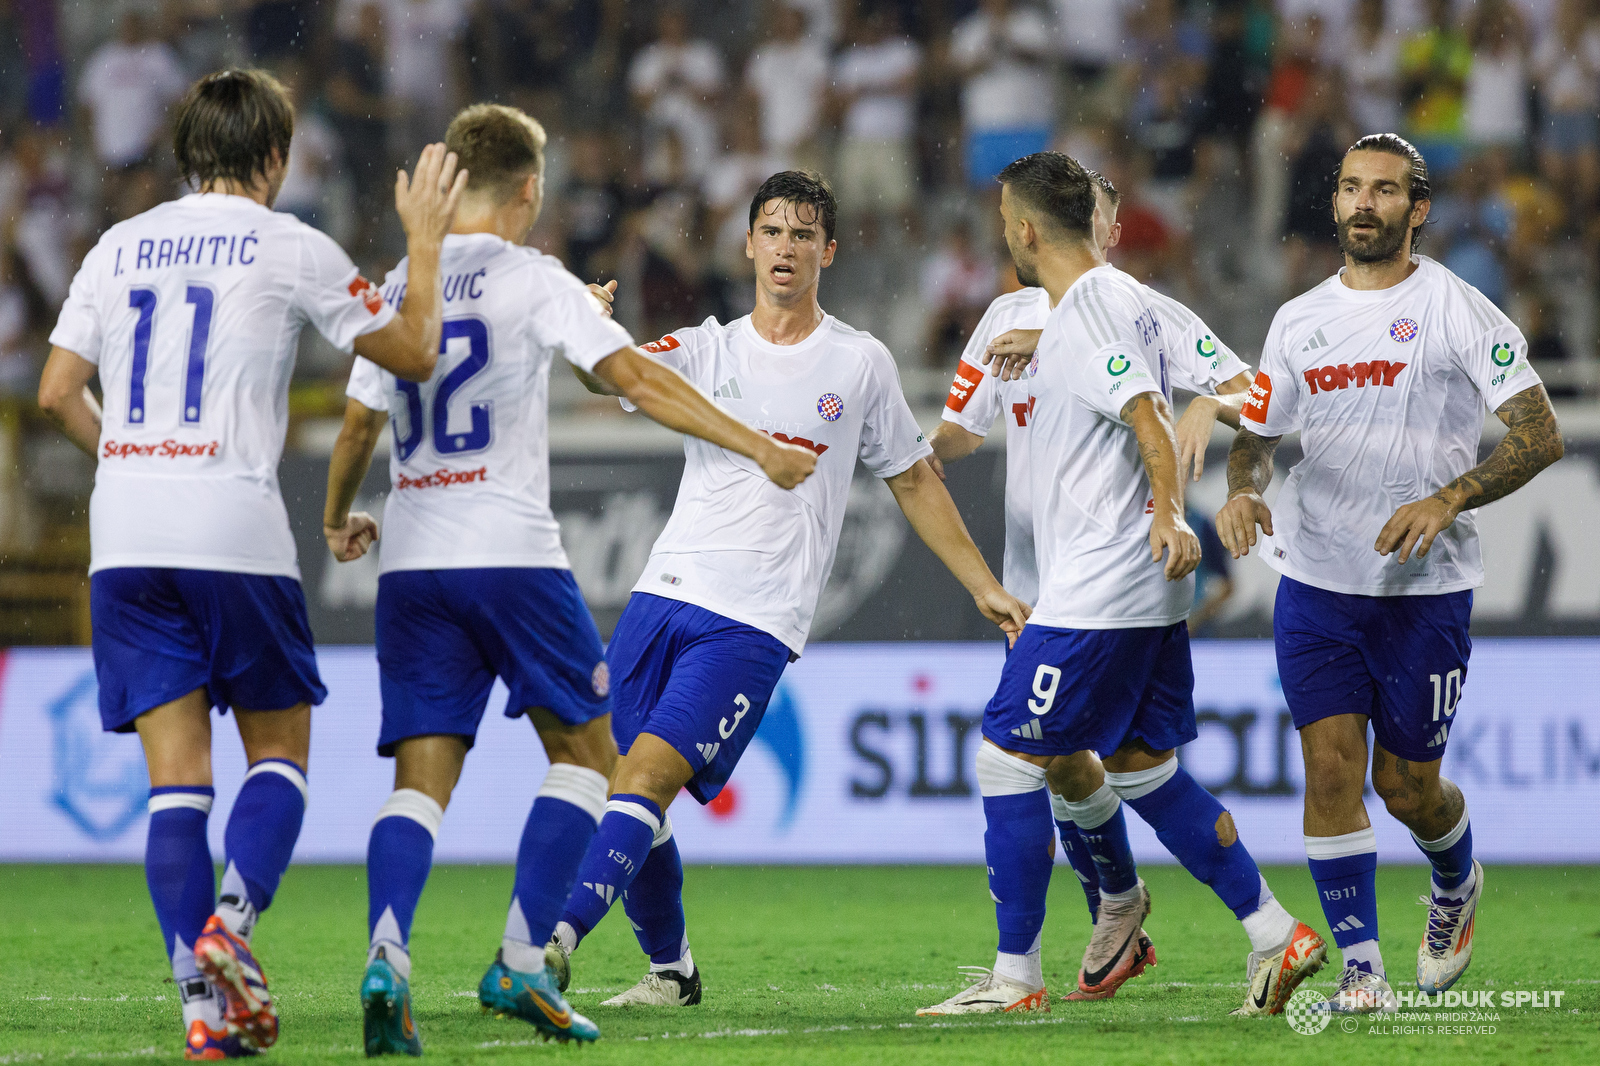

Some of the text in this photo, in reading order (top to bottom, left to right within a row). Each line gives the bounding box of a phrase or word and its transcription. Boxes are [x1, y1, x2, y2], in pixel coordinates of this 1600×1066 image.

[114, 230, 259, 277] I. RAKITIĆ
[125, 284, 217, 427] 11
[1303, 360, 1408, 395] TOMMY
[103, 439, 219, 459] SuperSport
[1028, 664, 1061, 715] 9
[1430, 668, 1462, 722] 10
[719, 693, 751, 740] 3
[607, 848, 635, 876] 1911
[1323, 886, 1357, 901] 1911
